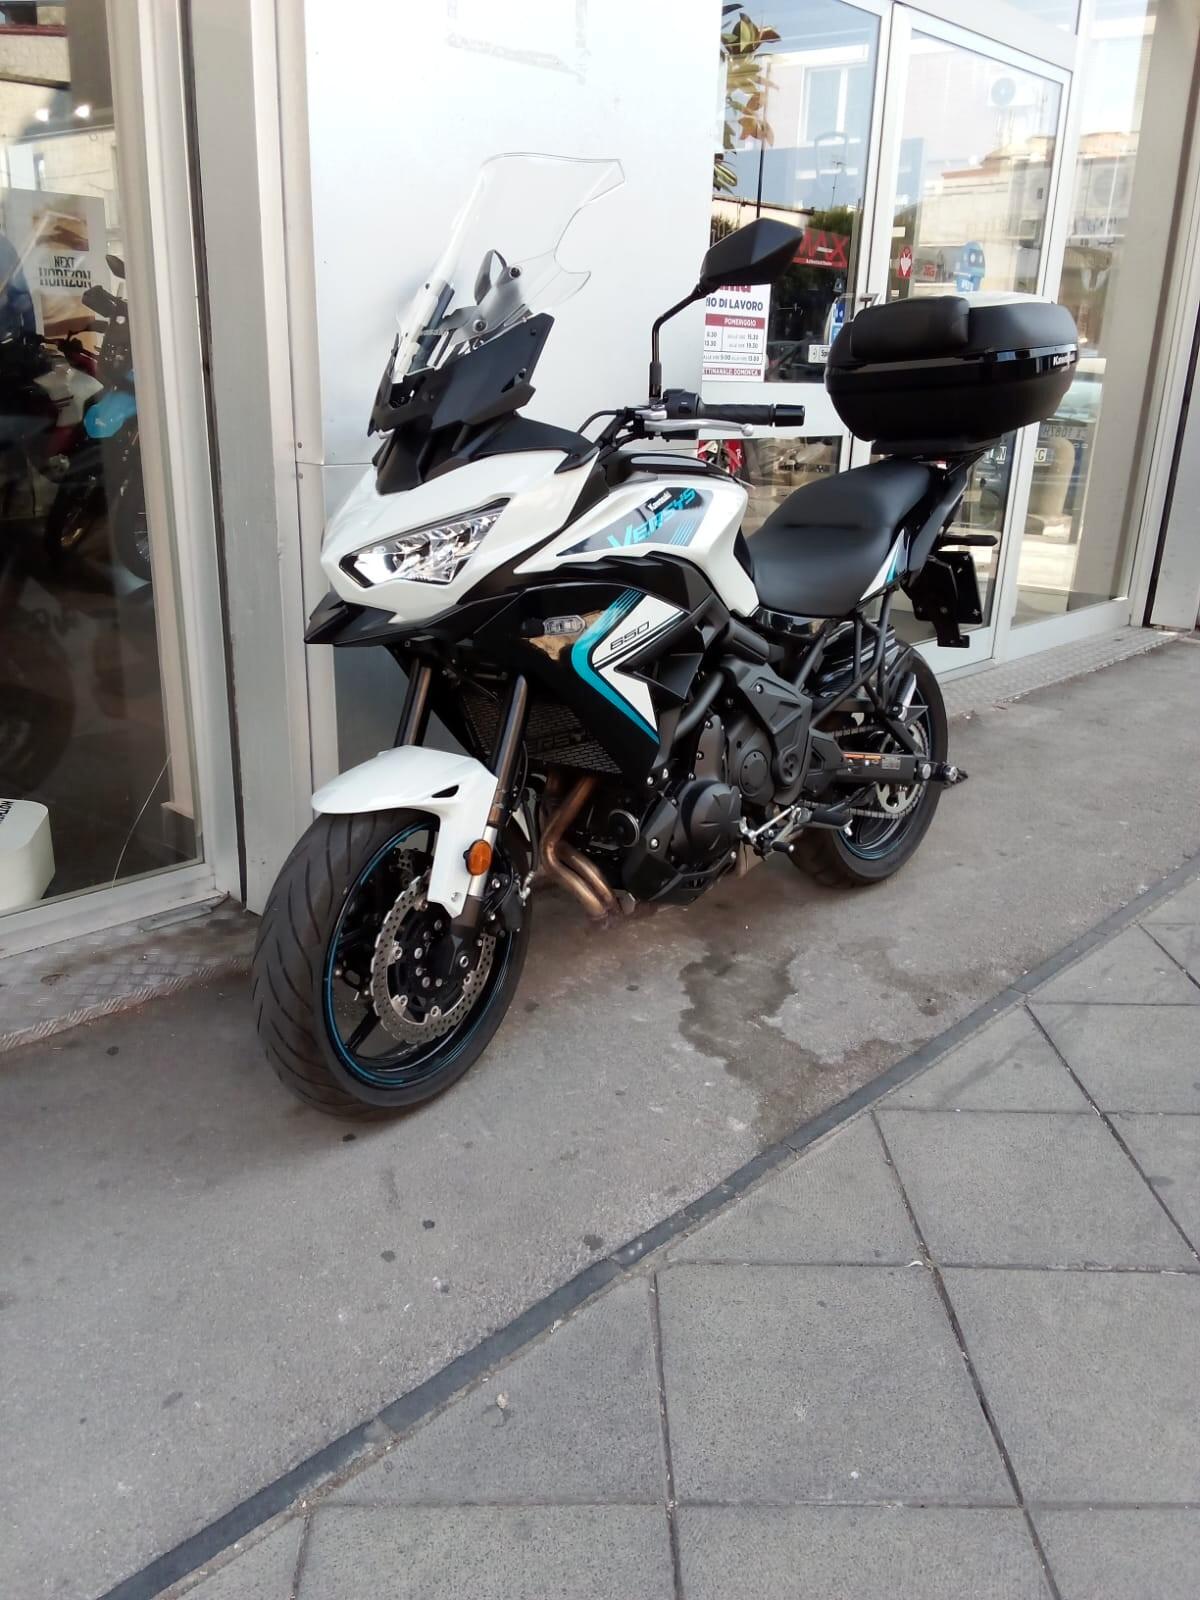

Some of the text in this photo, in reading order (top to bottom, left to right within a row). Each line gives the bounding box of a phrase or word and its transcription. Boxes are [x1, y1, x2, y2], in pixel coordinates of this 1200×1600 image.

[54, 256, 74, 268] NEXT
[39, 268, 91, 288] HORIZON
[719, 298, 728, 308] DI
[729, 299, 763, 311] LAVORO
[610, 621, 650, 651] 650
